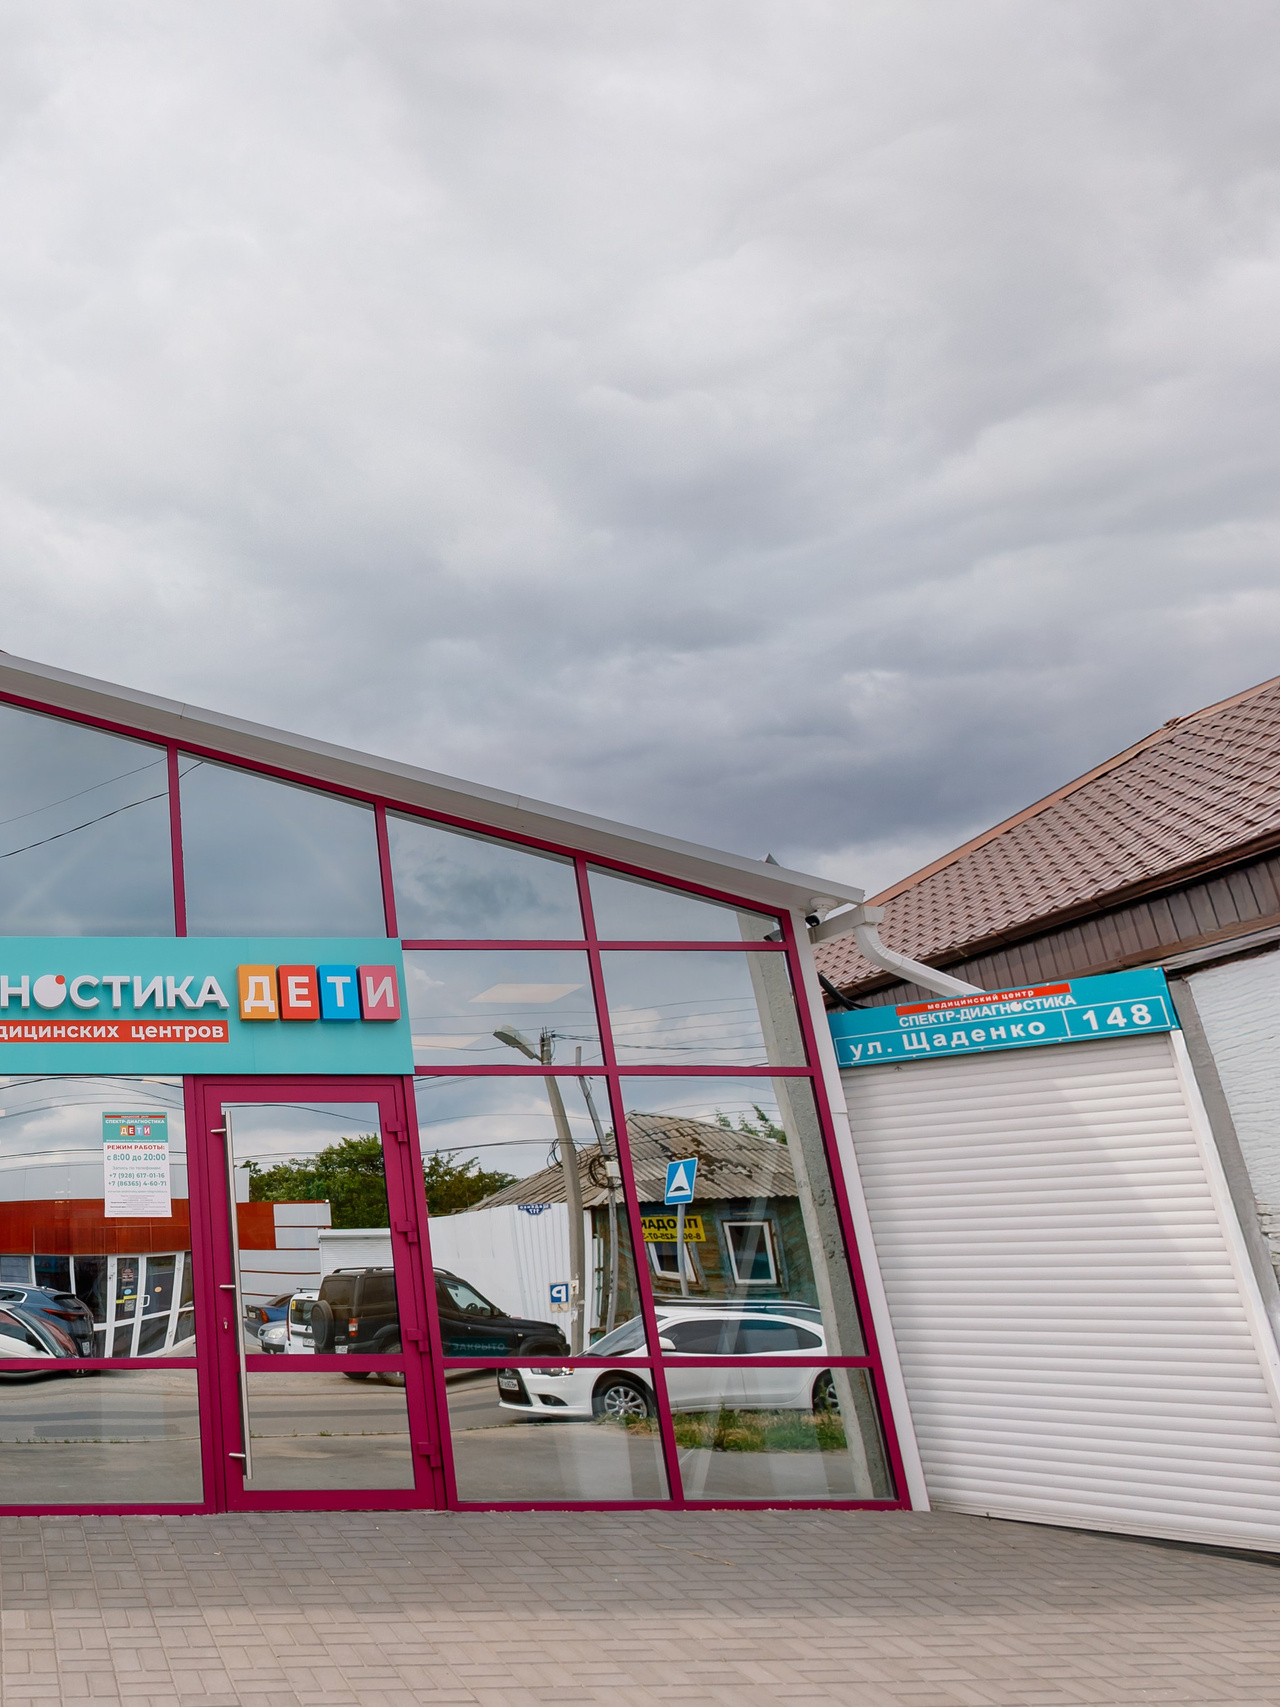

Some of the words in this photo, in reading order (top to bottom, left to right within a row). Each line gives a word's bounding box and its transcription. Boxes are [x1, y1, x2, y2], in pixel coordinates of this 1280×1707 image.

[241, 972, 397, 1016] ДЕТИ
[927, 994, 1000, 1010] медицинский
[1001, 989, 1035, 1002] центр
[898, 994, 1077, 1028] СПЕКТР-ДИАГНОСТИКА
[130, 1024, 224, 1042] центров
[849, 1039, 894, 1061] ул.
[902, 1020, 1047, 1051] Щаденко
[1081, 1003, 1152, 1031] 148
[120, 1126, 151, 1136] ДЕТИ
[113, 1153, 131, 1161] 8:00
[143, 1153, 166, 1161] 20:00
